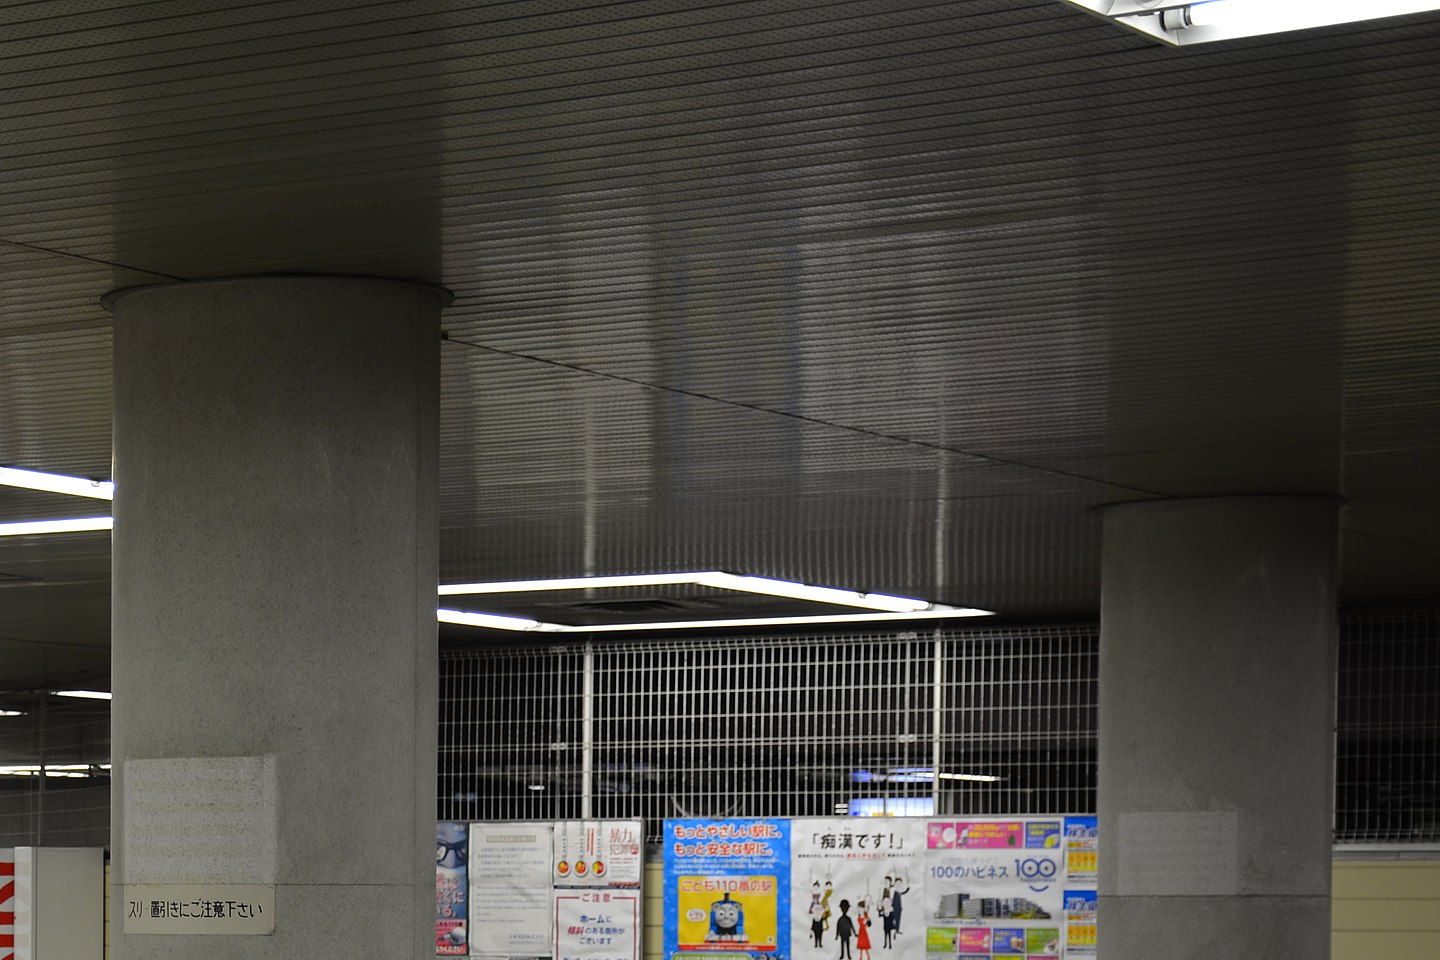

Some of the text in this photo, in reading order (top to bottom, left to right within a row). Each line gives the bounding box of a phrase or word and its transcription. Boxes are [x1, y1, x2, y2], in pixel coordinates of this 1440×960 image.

[681, 880, 773, 893] こども110番の駅
[128, 900, 263, 918] スリ・置引きにご注意下さい
